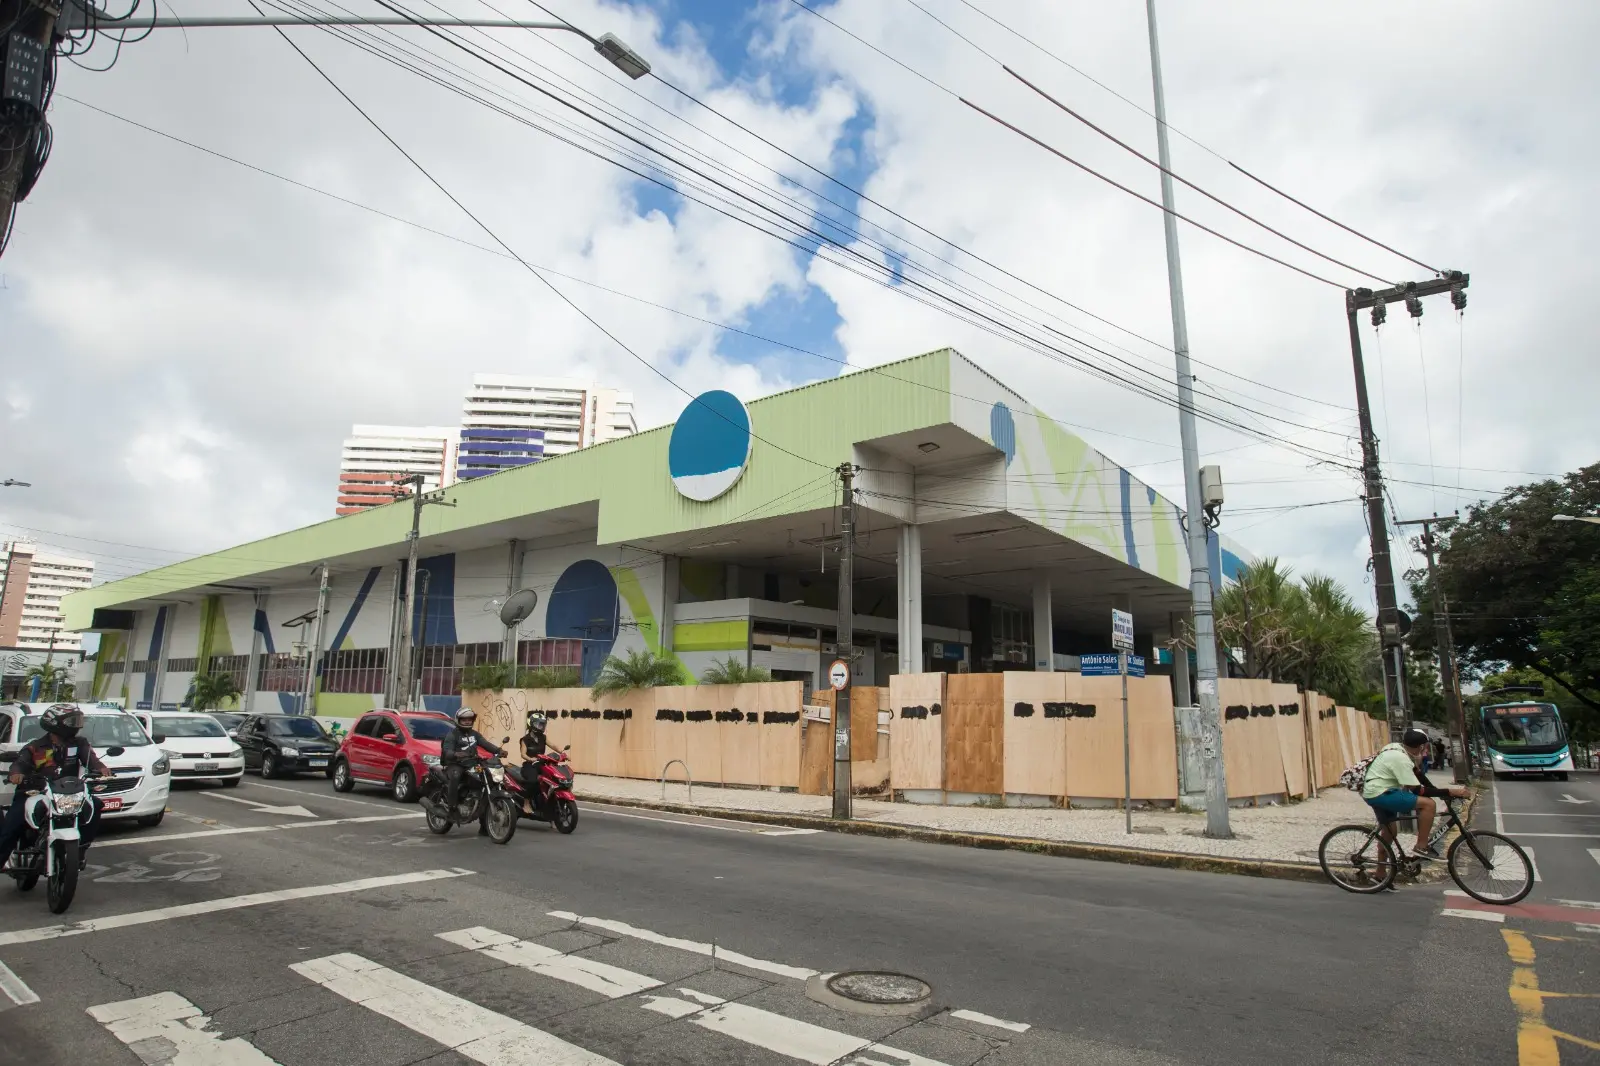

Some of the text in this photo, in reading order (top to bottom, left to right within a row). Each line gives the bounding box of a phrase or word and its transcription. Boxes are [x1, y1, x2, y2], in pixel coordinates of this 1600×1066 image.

[1081, 655, 1118, 665] Antônio Sales
[1432, 824, 1449, 841] CALOI
